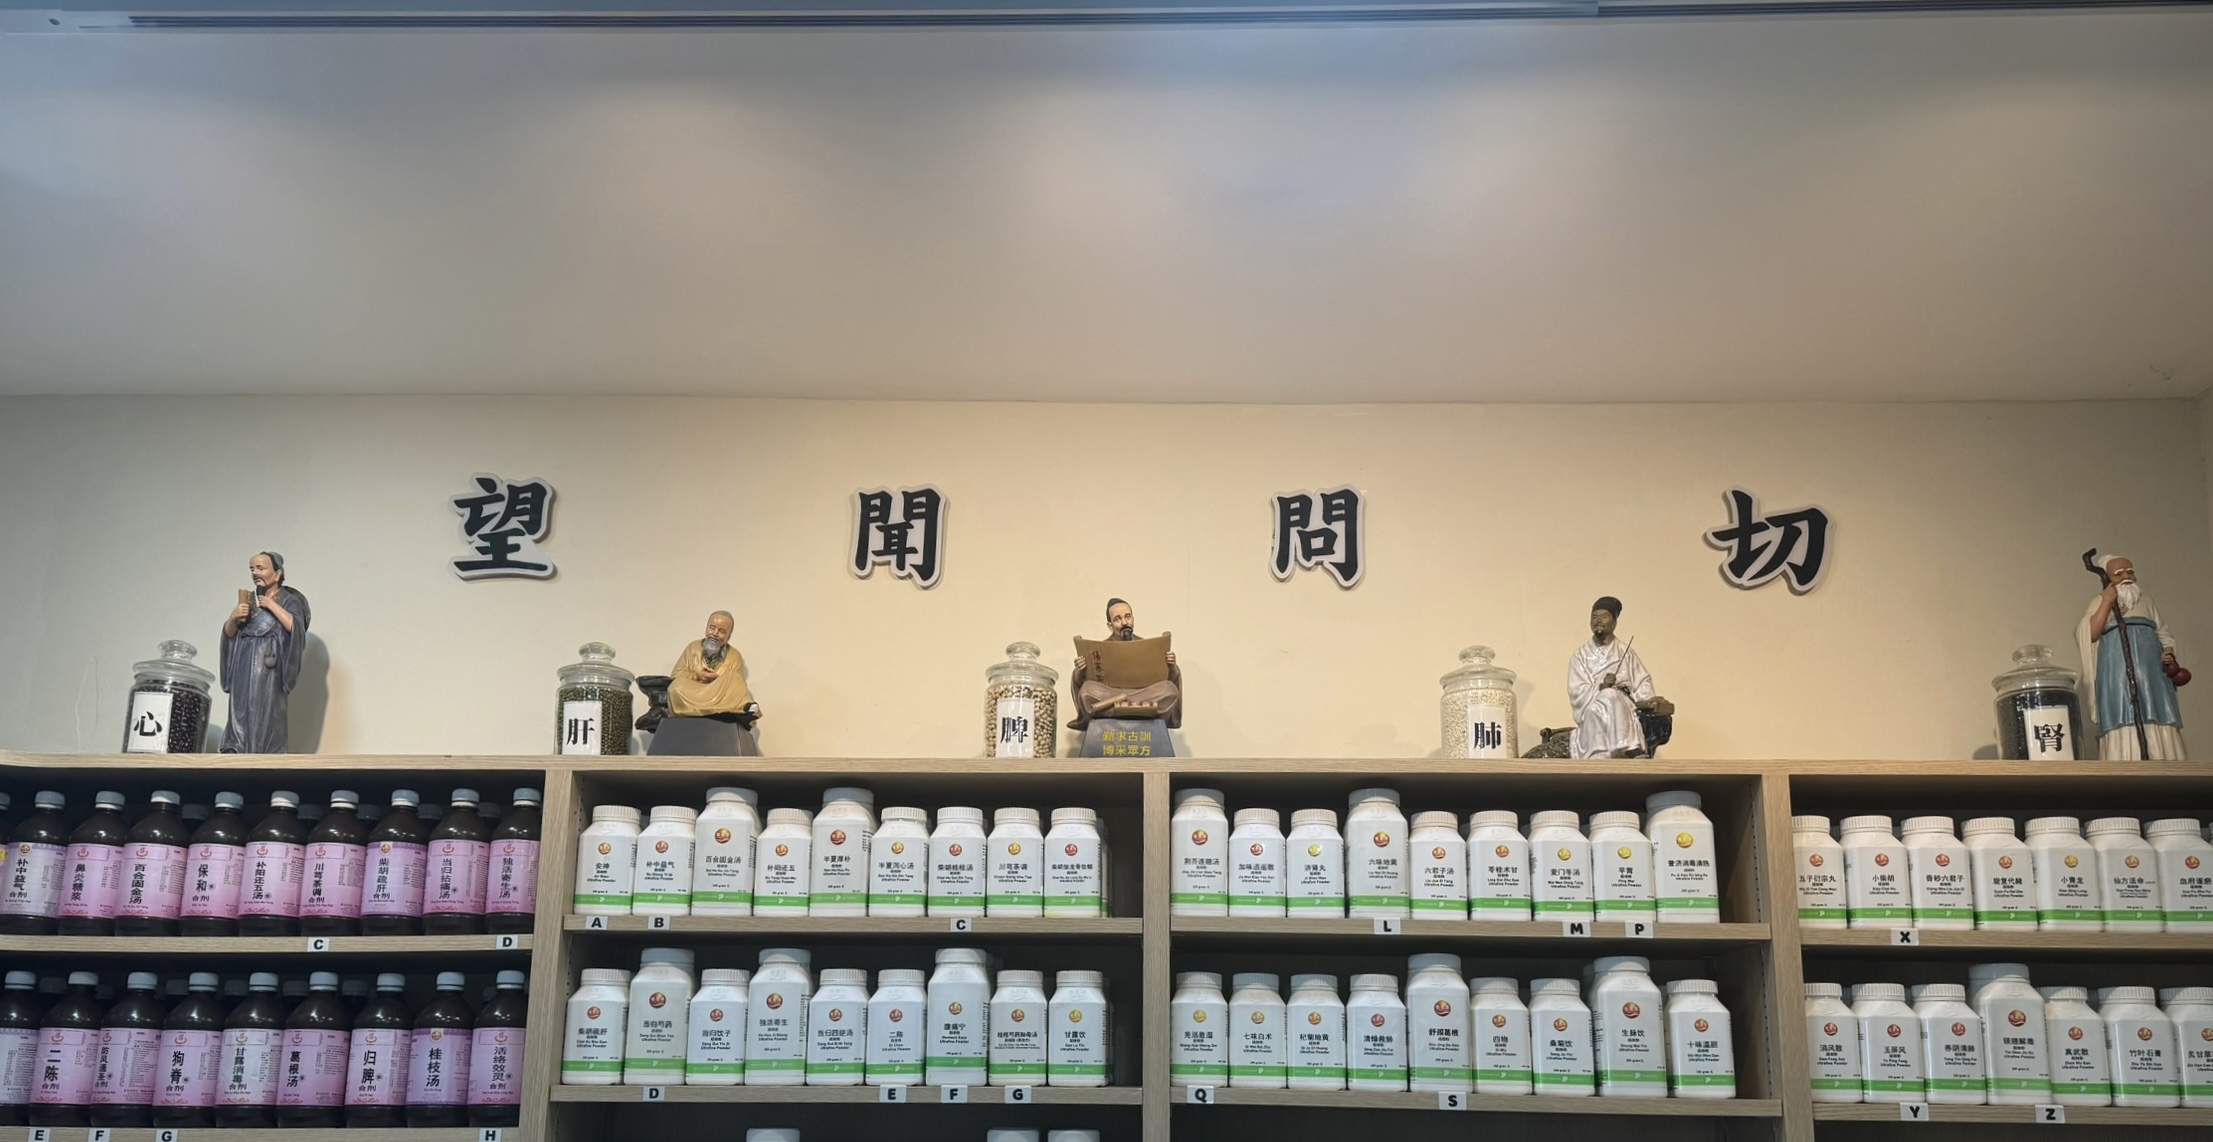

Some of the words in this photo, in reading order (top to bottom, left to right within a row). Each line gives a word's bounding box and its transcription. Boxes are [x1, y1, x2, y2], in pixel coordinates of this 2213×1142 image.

[454, 477, 548, 573] 望
[855, 488, 941, 581] 聞
[1276, 489, 1359, 581] 問
[1712, 489, 1828, 585] 切
[134, 712, 162, 736] 心
[1001, 717, 1028, 743] 脾
[567, 718, 595, 745] 肝
[1473, 722, 1501, 749] 肺
[2034, 723, 2065, 752] 腎
[14, 859, 28, 891] 补中益气
[195, 864, 208, 892] 保和
[252, 861, 267, 899] 补阳还五汤
[377, 858, 389, 892] 柴胡疏肝
[499, 857, 513, 898] 独活寄生汤
[129, 864, 147, 904] 百合固金汤
[592, 918, 602, 928] A
[654, 918, 664, 927] B
[956, 920, 966, 930] C
[1383, 921, 1391, 932] L
[1570, 924, 1583, 934] M
[1635, 924, 1644, 934] P
[503, 938, 512, 947] D
[1900, 931, 1911, 943] X
[314, 940, 323, 950] C
[44, 1050, 61, 1081] 二陈
[170, 1051, 184, 1084] 狗脊
[232, 1047, 246, 1083] 甘露消毒
[286, 1051, 302, 1087] 葛根汤
[361, 1050, 376, 1084] 归脾
[426, 1048, 442, 1087] 桂枝汤
[491, 1047, 507, 1081] 活络效灵
[649, 1089, 659, 1098] D
[888, 1089, 896, 1100] E
[949, 1089, 958, 1100] F
[1013, 1089, 1023, 1100] G
[1195, 1089, 1207, 1102] Q
[1448, 1095, 1457, 1106] S
[1910, 1106, 1919, 1118] Y
[2046, 1109, 2055, 1120] Z
[35, 1131, 44, 1140] E
[95, 1131, 104, 1140] F
[161, 1132, 172, 1141] G
[485, 1130, 495, 1141] H
